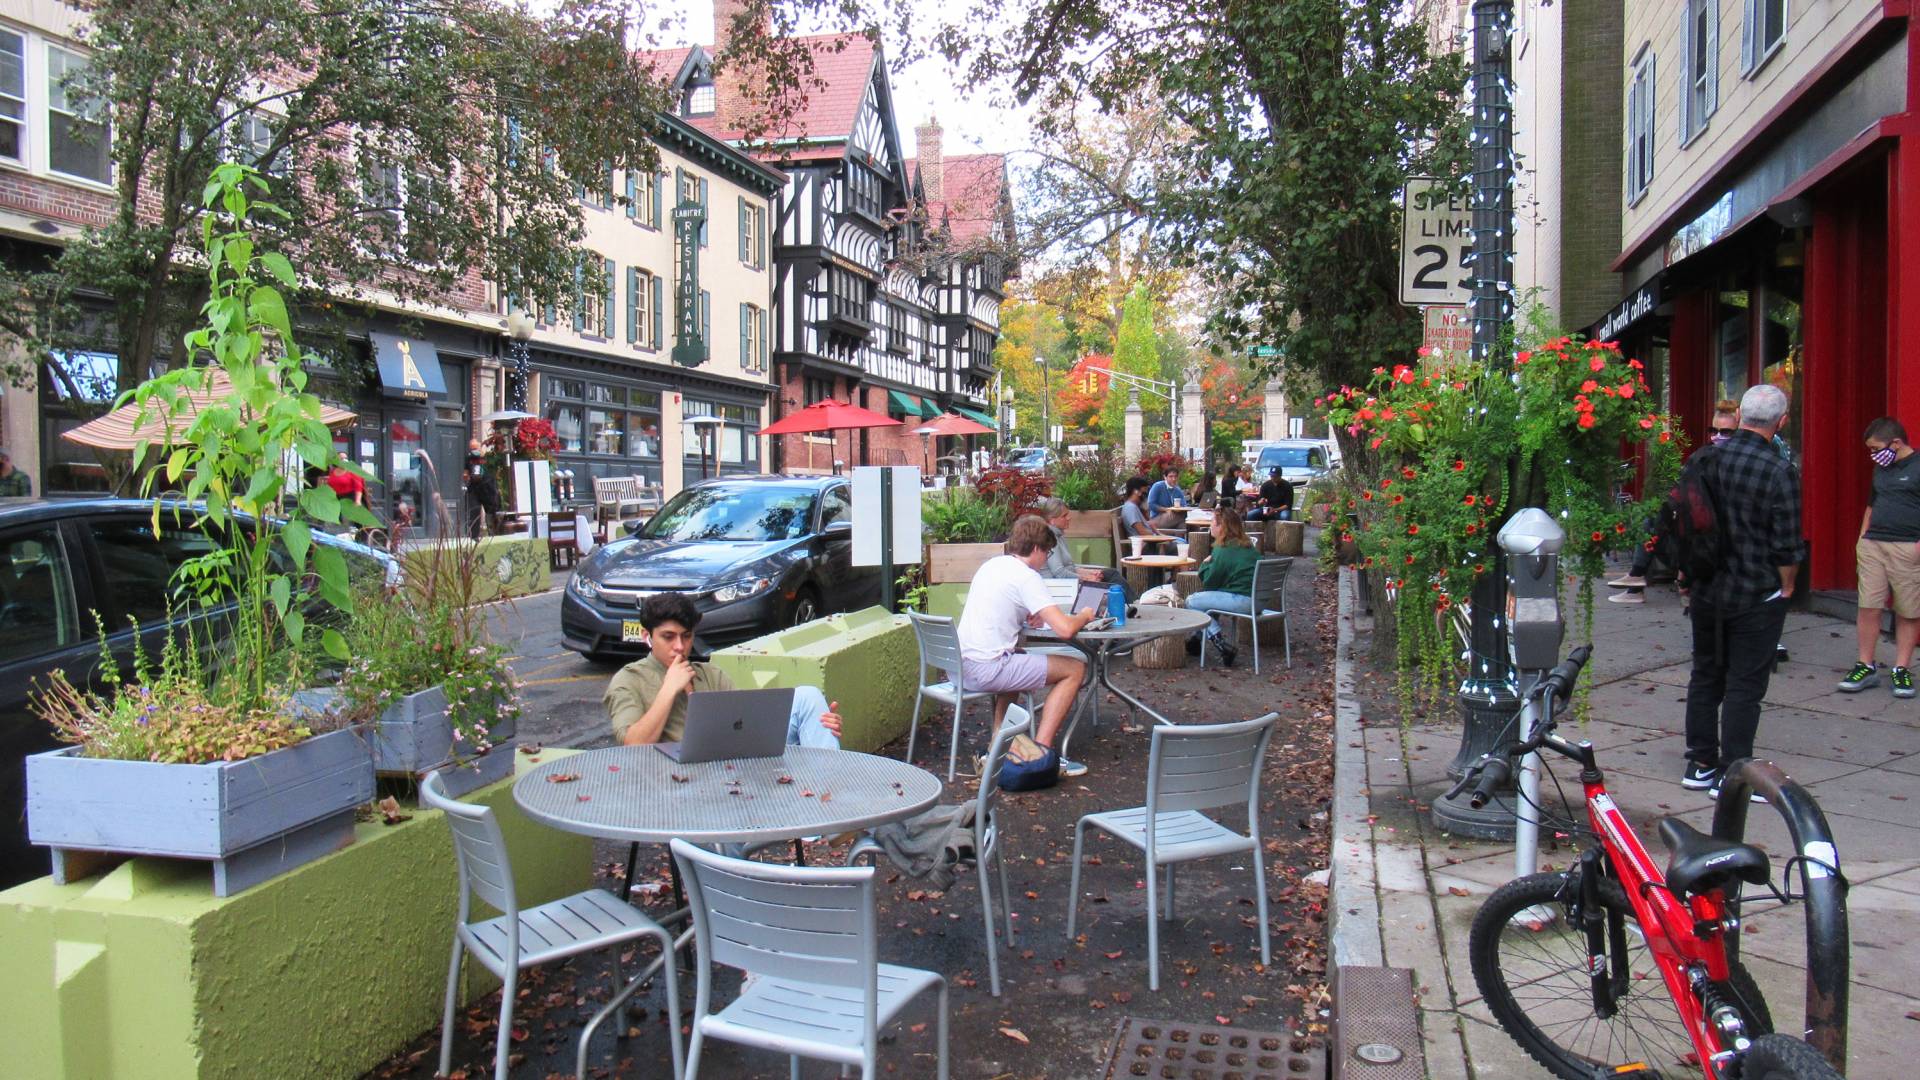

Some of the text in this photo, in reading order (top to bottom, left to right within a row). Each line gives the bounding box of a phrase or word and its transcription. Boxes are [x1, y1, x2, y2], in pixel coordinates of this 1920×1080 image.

[1413, 192, 1473, 211] SEE
[1421, 219, 1472, 238] LIMI
[684, 221, 693, 347] RESTAURANT
[1442, 313, 1458, 326] NO
[1599, 288, 1652, 342] small world coffee
[403, 389, 428, 399] AGRICOLA
[1705, 853, 1736, 867] NEXT
